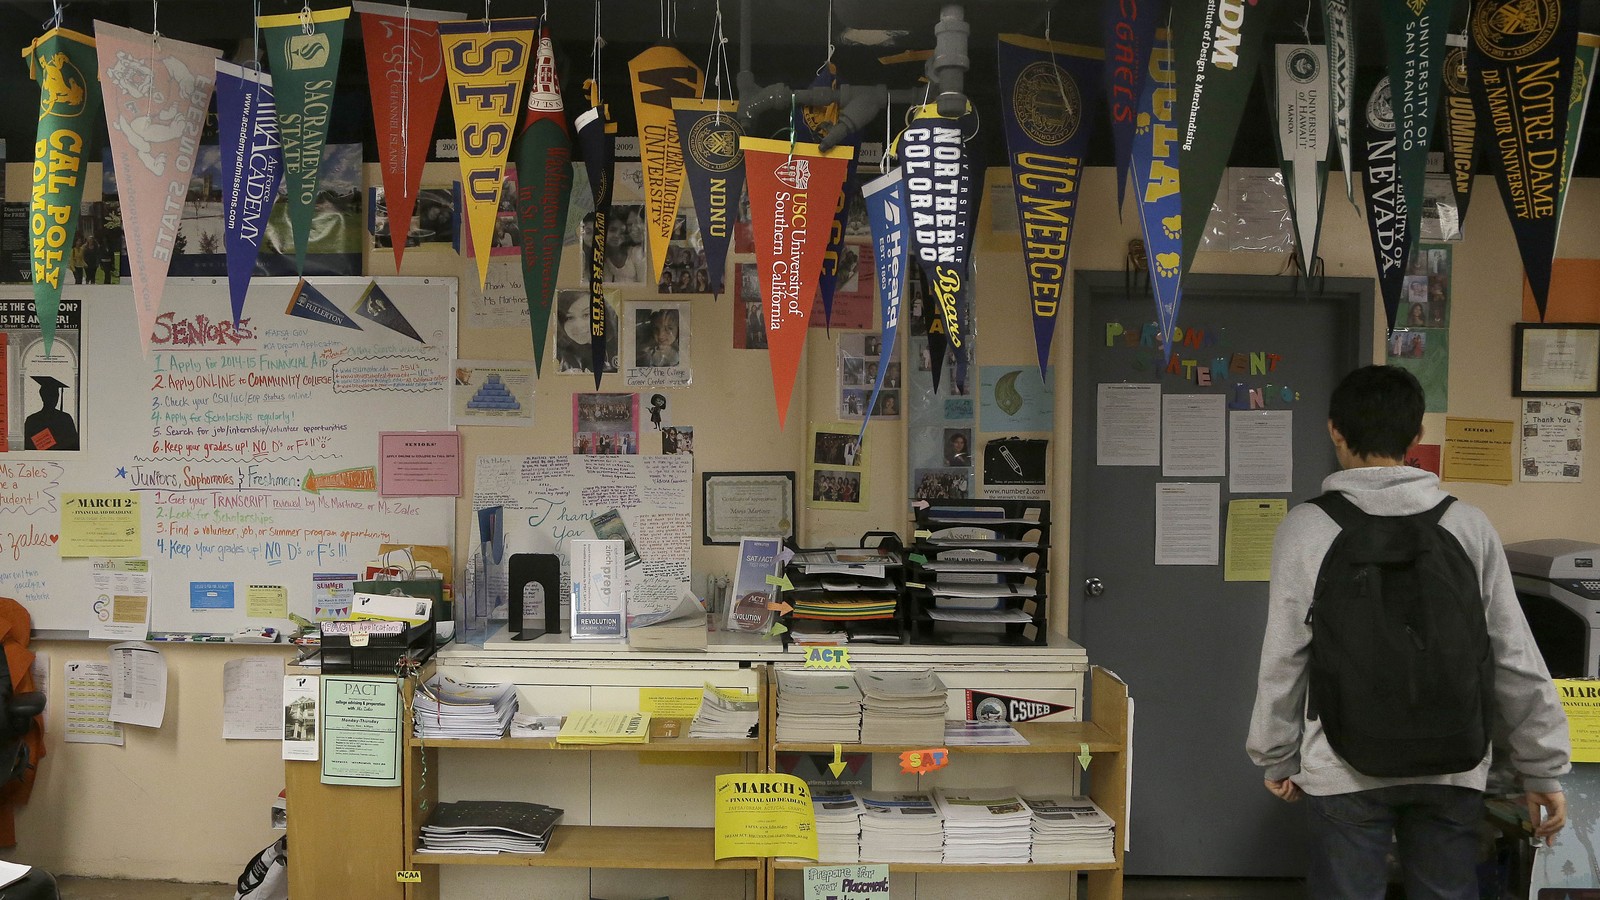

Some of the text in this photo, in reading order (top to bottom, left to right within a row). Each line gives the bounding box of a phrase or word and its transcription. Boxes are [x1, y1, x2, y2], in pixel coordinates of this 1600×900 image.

[1196, 41, 1210, 72] Design
[1403, 21, 1416, 152] SAN FRANCISCO
[1417, 16, 1430, 148] UNIVERSITY OF
[1299, 91, 1307, 101] of
[389, 82, 400, 175] CHANNEL ISLANDS
[448, 37, 528, 205] SFSU
[1144, 47, 1181, 203] UCLA
[1182, 82, 1204, 152] Merchandising
[1308, 89, 1318, 151] UNIVERSITY
[279, 113, 302, 175] STATE
[300, 80, 333, 206] SACRAMENTO
[1450, 96, 1477, 193] DOMINICAN
[1481, 69, 1530, 219] DE NAMUR UNIVERSITY
[1516, 57, 1560, 219] NOTRE DAME
[228, 93, 252, 230] www.academyadmissions.com
[240, 121, 282, 247] ACADEMY
[263, 155, 279, 203] Air Force
[644, 124, 667, 226] UNIVERSITY
[661, 177, 681, 238] MICHIGAN
[903, 127, 938, 263] COLORADO
[934, 127, 963, 263] NORTHERN
[1367, 136, 1397, 272] NEVADA
[32, 138, 48, 284] POMONA
[46, 129, 83, 289] CAL POLY
[710, 178, 726, 239] NDNU
[770, 191, 791, 331] Southern California
[788, 192, 808, 318] USC University of
[1020, 201, 1078, 318] MERCED
[484, 281, 522, 291] Thank You
[890, 230, 902, 329] Heald
[10, 302, 25, 312] THE
[10, 314, 25, 324] THE
[304, 302, 344, 325] FULLERTON
[933, 264, 962, 350] Bears
[170, 354, 202, 373] Apply
[205, 357, 218, 370] for
[220, 355, 257, 369] 2014-15
[260, 354, 308, 371] FINANCIAL
[627, 368, 639, 378] I
[151, 374, 167, 391] 2.
[168, 374, 195, 392] Apply
[196, 371, 236, 389] ONLINE
[248, 372, 302, 390] COMMUNITY
[152, 396, 210, 411] 3. Check your
[152, 427, 162, 437] 5.
[166, 425, 193, 435] Search
[196, 426, 209, 435] for
[303, 423, 348, 434] opportunities
[165, 412, 187, 427] Apply
[189, 412, 202, 423] for
[257, 411, 294, 425] regularly!
[1532, 416, 1572, 424] Thank You
[152, 440, 164, 454] 6.
[165, 440, 183, 455] Keep
[185, 443, 200, 457] your
[203, 441, 234, 458] grades
[252, 440, 267, 453] NO
[16, 463, 48, 479] Zales
[77, 498, 121, 508] MARCH
[168, 493, 187, 505] Get
[189, 496, 208, 510] your
[210, 491, 272, 509] TRANSCRIPT
[304, 497, 316, 513] by
[330, 496, 365, 510] Martinez
[367, 502, 374, 510] or
[393, 502, 421, 516] Zales
[169, 506, 192, 519] Look
[196, 508, 208, 519] for
[169, 521, 189, 536] Find
[259, 528, 267, 536] or
[304, 529, 337, 543] program
[339, 529, 391, 543] opportunity
[156, 539, 168, 554] 4.
[169, 539, 191, 559] Keep
[217, 544, 245, 562] grades
[264, 541, 281, 560] NO
[306, 549, 315, 557] or
[316, 581, 344, 590] SUMMER
[600, 566, 612, 596] prep
[748, 594, 765, 602] ACT
[580, 617, 617, 625] REVOLUTION
[808, 648, 844, 663] ACT
[343, 683, 381, 696] PACT
[1009, 699, 1051, 722] CSUEB
[909, 751, 944, 768] SAT
[734, 782, 795, 795] MARCH
[777, 797, 807, 807] DEADLINE
[397, 871, 420, 879] NCAA
[809, 867, 851, 883] Prepare
[842, 877, 889, 893] Placement
